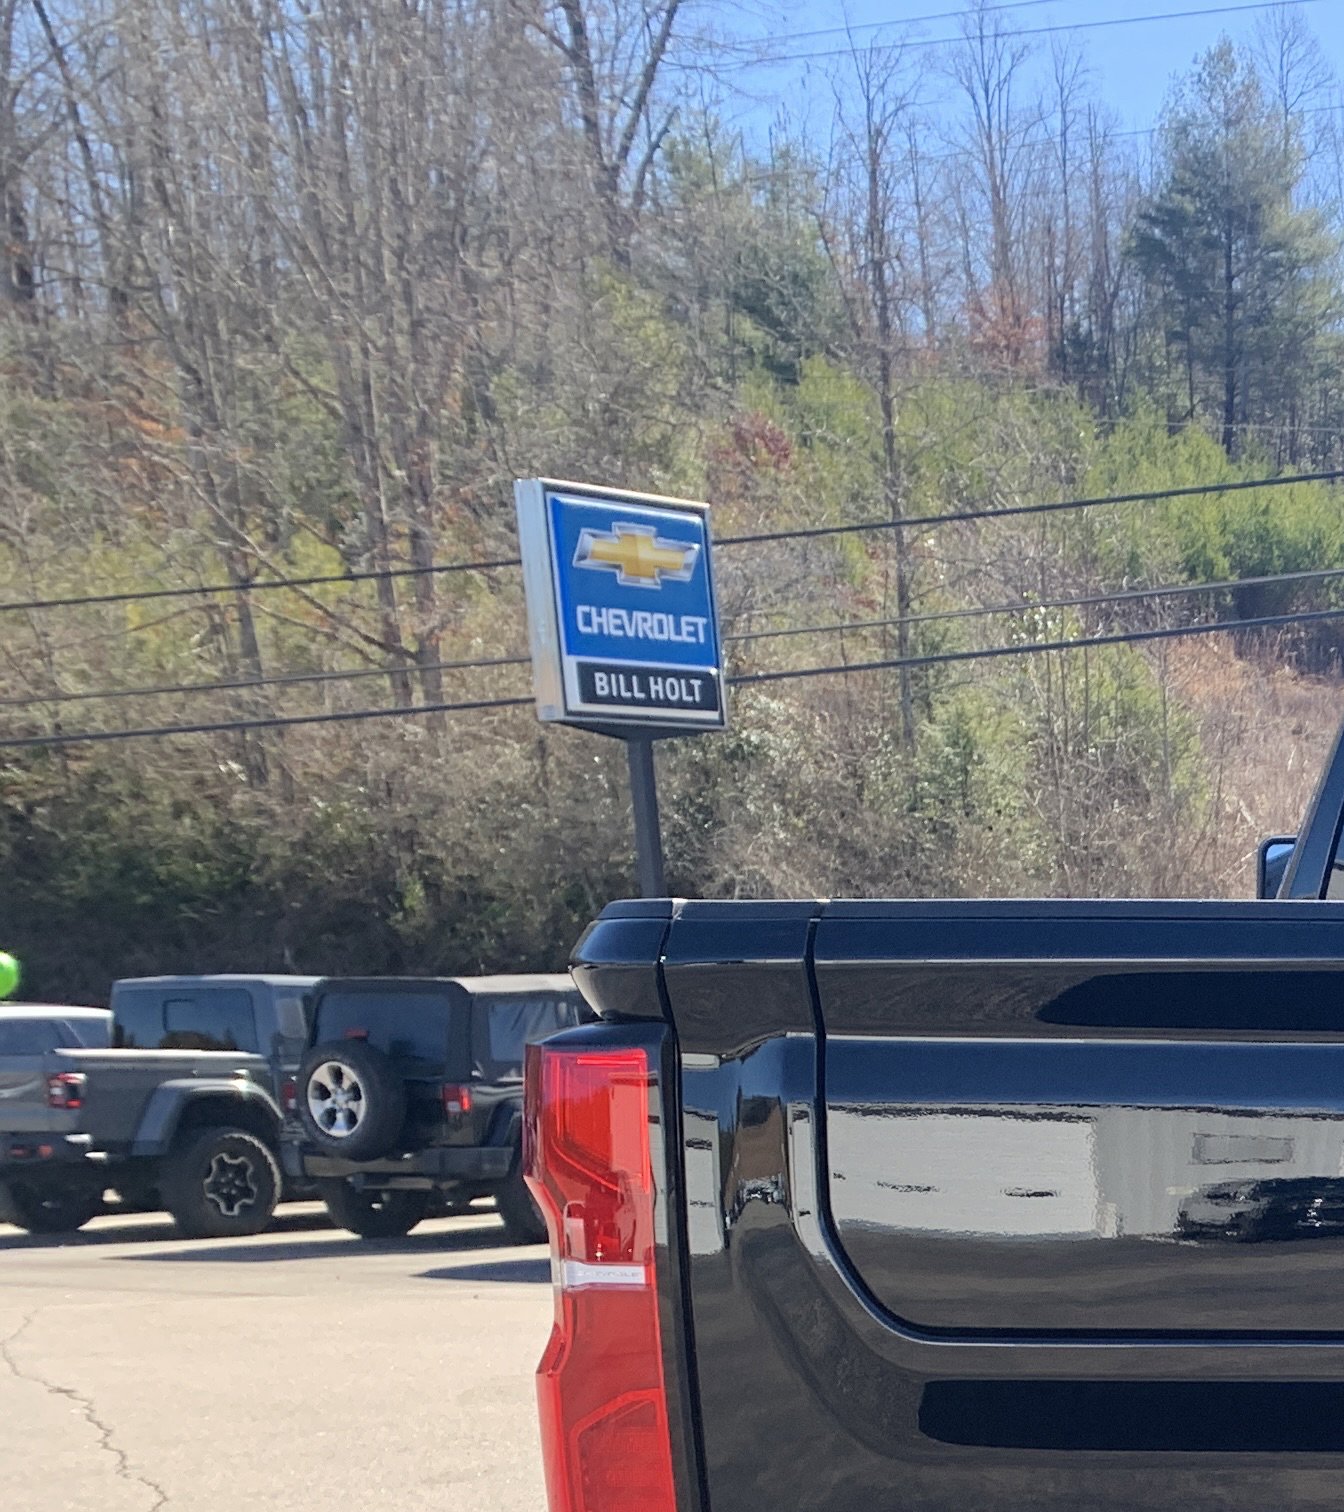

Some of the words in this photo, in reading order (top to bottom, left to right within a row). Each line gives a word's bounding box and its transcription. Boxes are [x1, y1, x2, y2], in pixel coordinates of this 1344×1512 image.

[576, 605, 707, 643] CHEVROLET
[594, 672, 646, 699] BILL
[648, 675, 702, 702] HOLT
